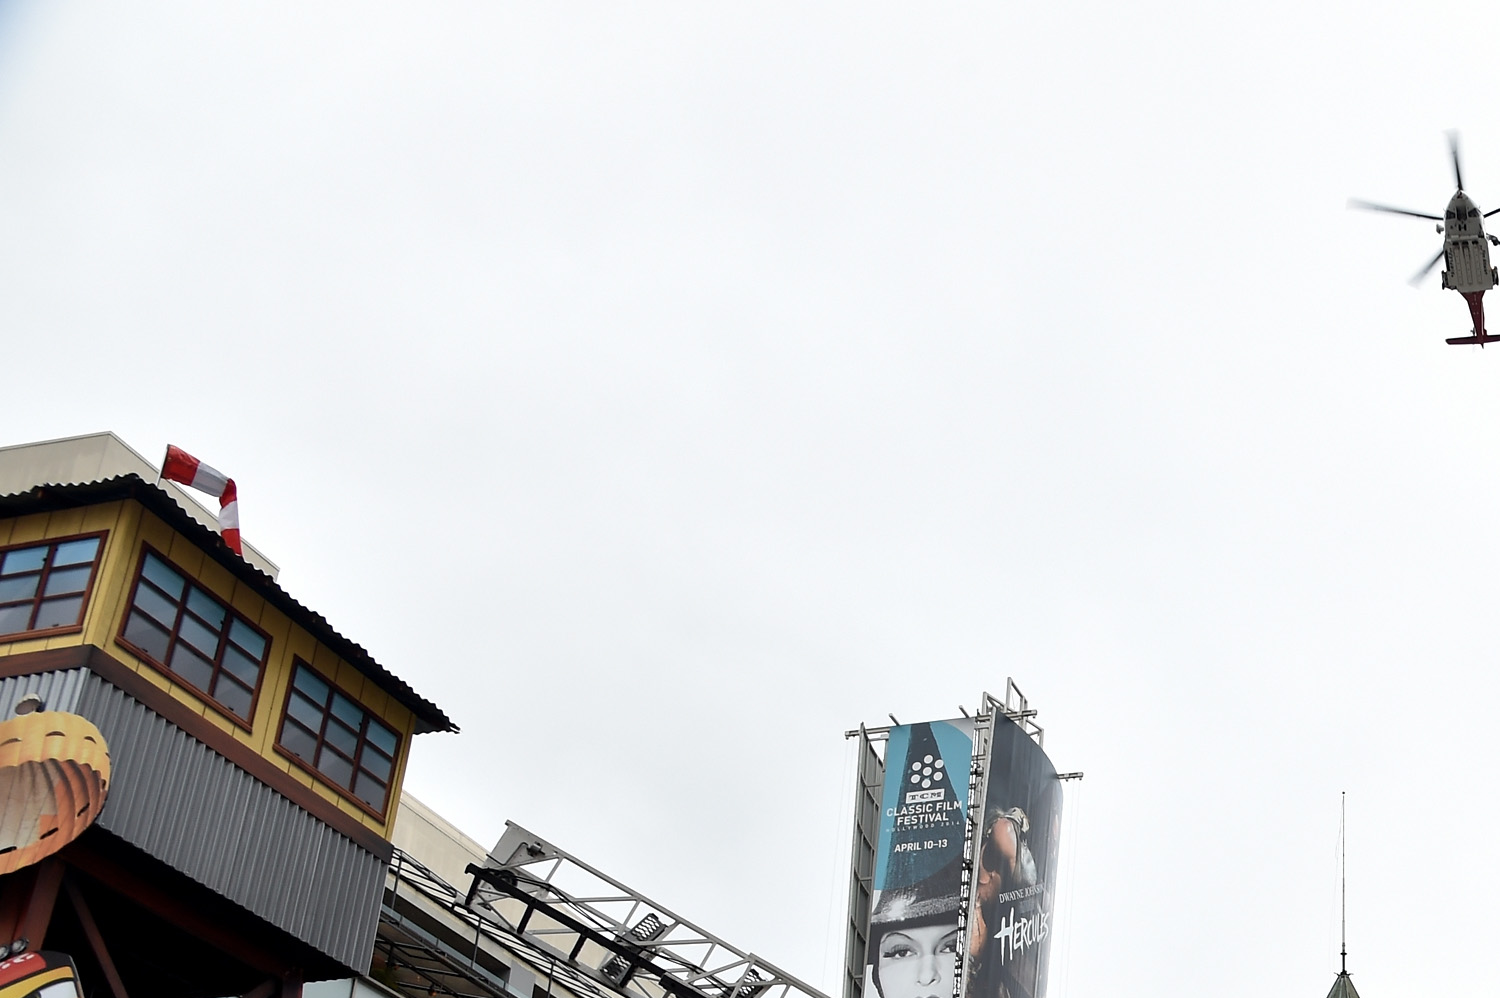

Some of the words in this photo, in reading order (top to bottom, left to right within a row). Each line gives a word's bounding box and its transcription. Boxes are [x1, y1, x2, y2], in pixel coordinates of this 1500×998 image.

[907, 791, 943, 800] TCM
[886, 803, 933, 817] CLASSIC
[936, 800, 963, 812] FILM
[897, 812, 949, 826] FESTIVAL
[894, 842, 922, 853] APRIL
[999, 888, 1025, 904] DWAYNE
[994, 906, 1050, 967] HERCULES
